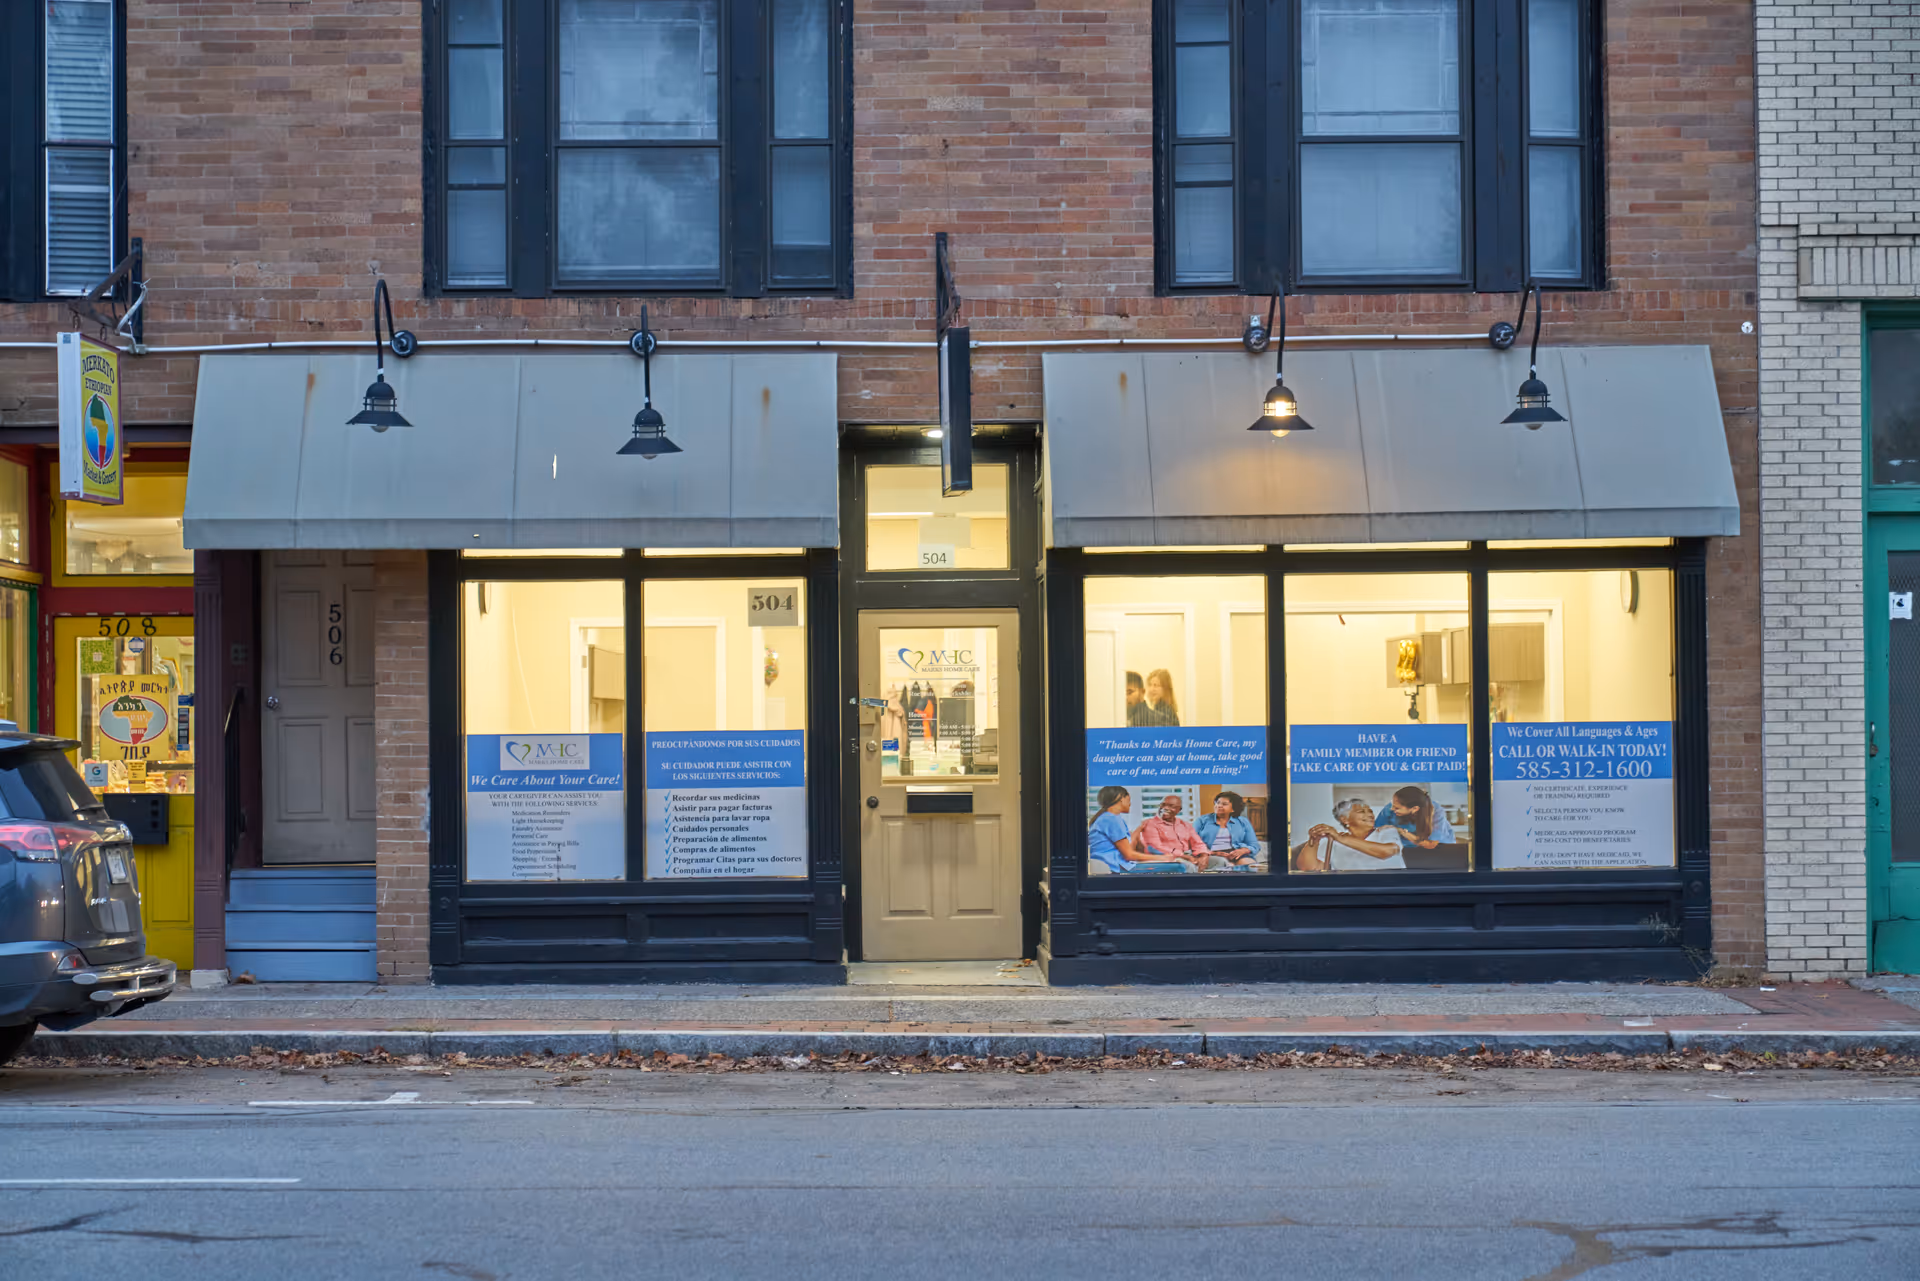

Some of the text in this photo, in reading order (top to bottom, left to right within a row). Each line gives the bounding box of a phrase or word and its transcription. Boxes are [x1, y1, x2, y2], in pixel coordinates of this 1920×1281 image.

[82, 355, 114, 384] MERKATO
[85, 377, 112, 396] ETHIOPIAN
[922, 552, 947, 565] 504
[752, 594, 794, 611] 504
[99, 617, 157, 636] 508
[328, 604, 343, 666] 506
[929, 650, 973, 664] MHC
[1358, 734, 1397, 743] HAVE A
[1508, 726, 1658, 739] We Cover All Languages & Ages
[727, 740, 743, 748] POR
[761, 739, 800, 747] CUIDADOS
[1099, 738, 1257, 749] "Thanks to Marks Home Care, my
[536, 743, 578, 757] MHC
[1301, 747, 1457, 758] FAMILY MEMBER OR FRIEND
[1499, 744, 1666, 758] CALL OR WALK-IN TODAY!
[1093, 754, 1134, 764] daughter
[1156, 754, 1174, 763] stay
[1188, 752, 1215, 762] home,
[1218, 752, 1237, 761] take
[1240, 751, 1263, 762] good
[661, 762, 671, 770] SU
[716, 761, 741, 769] PUEDE
[1129, 767, 1141, 777] of
[1141, 768, 1158, 776] me,
[1160, 767, 1177, 775] and
[1212, 764, 1249, 775] living!"
[1292, 761, 1466, 772] TAKE CARE OF YOU & GET PAID!
[1516, 760, 1652, 779] 585-312-1600
[472, 774, 620, 786] We Care About Your Care!
[690, 772, 735, 780] SIGUIENTES
[737, 771, 781, 779] SERVICIOS:
[699, 805, 716, 813] para
[672, 825, 749, 834] Cuidados personales
[673, 836, 717, 844] Preparación
[673, 846, 707, 855] Compras
[673, 856, 714, 865] Programar
[733, 866, 755, 874] hogar
